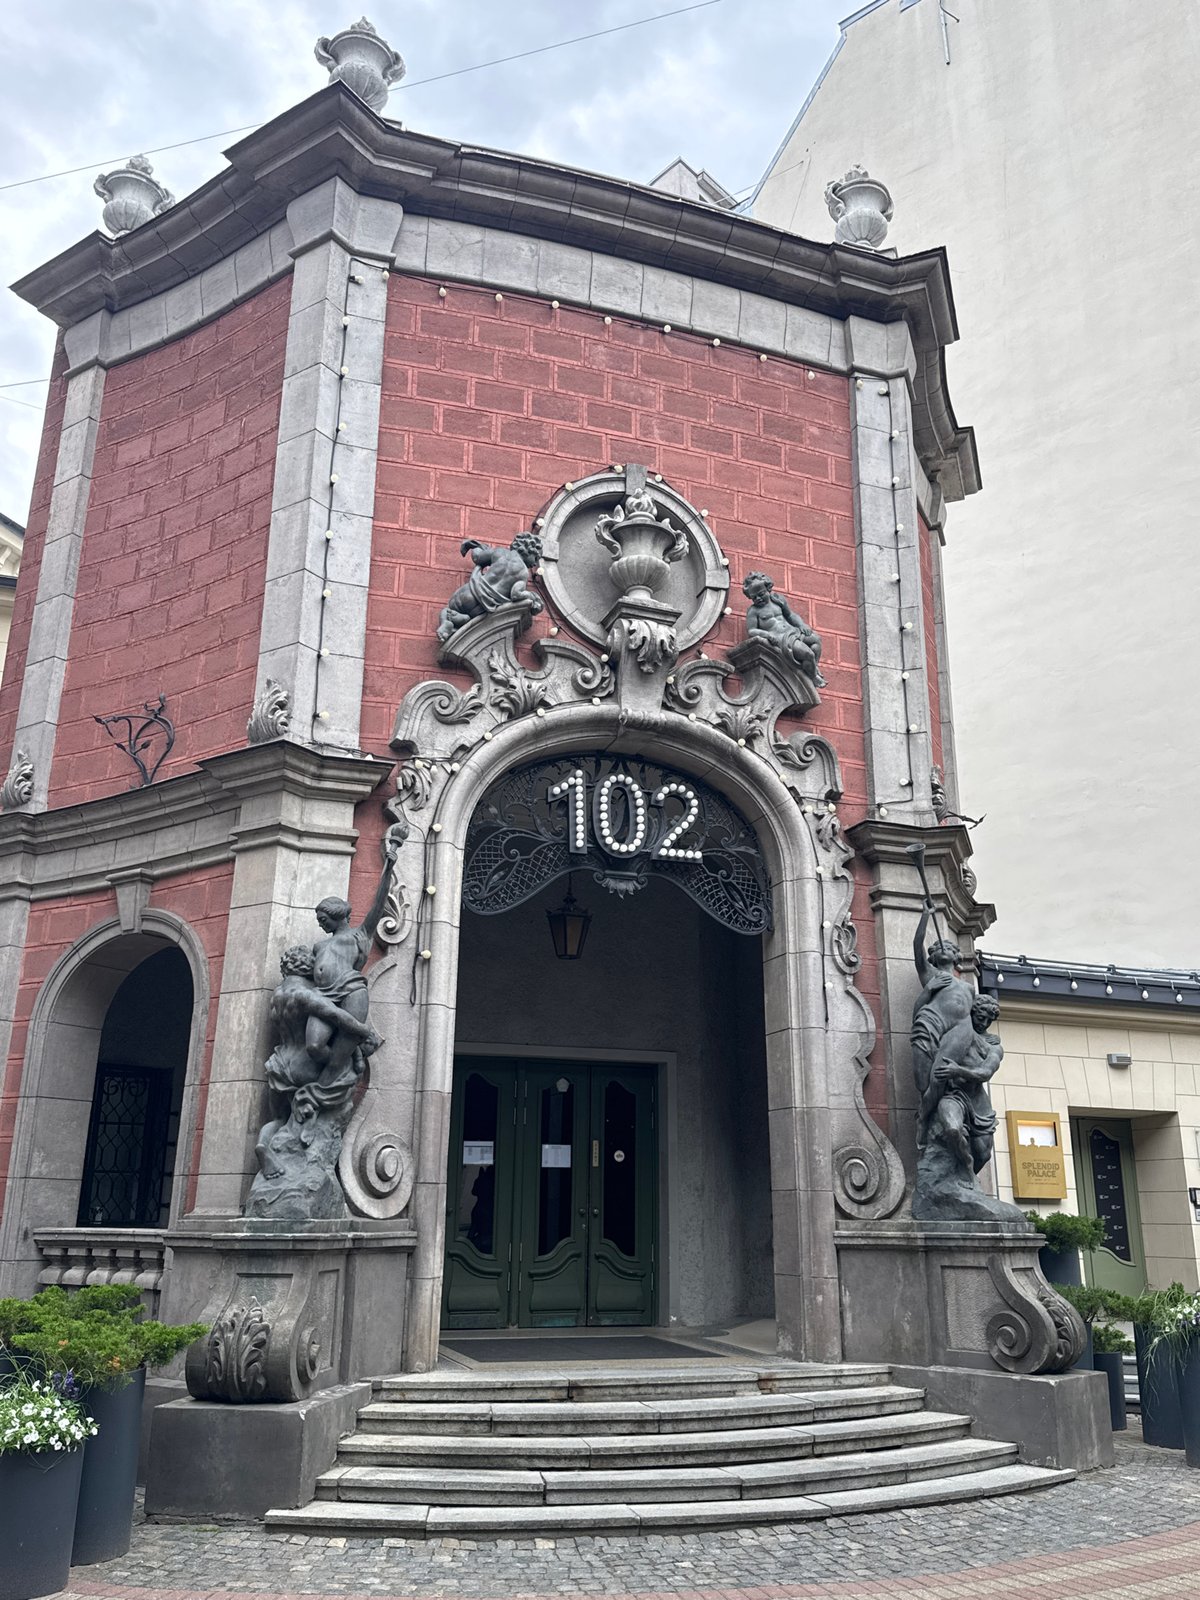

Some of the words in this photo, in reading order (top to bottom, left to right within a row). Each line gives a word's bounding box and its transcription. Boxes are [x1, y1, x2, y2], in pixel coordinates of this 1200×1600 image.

[548, 769, 703, 864] 102
[1022, 1162, 1060, 1170] SPLENDID
[1027, 1170, 1057, 1178] PALACE
